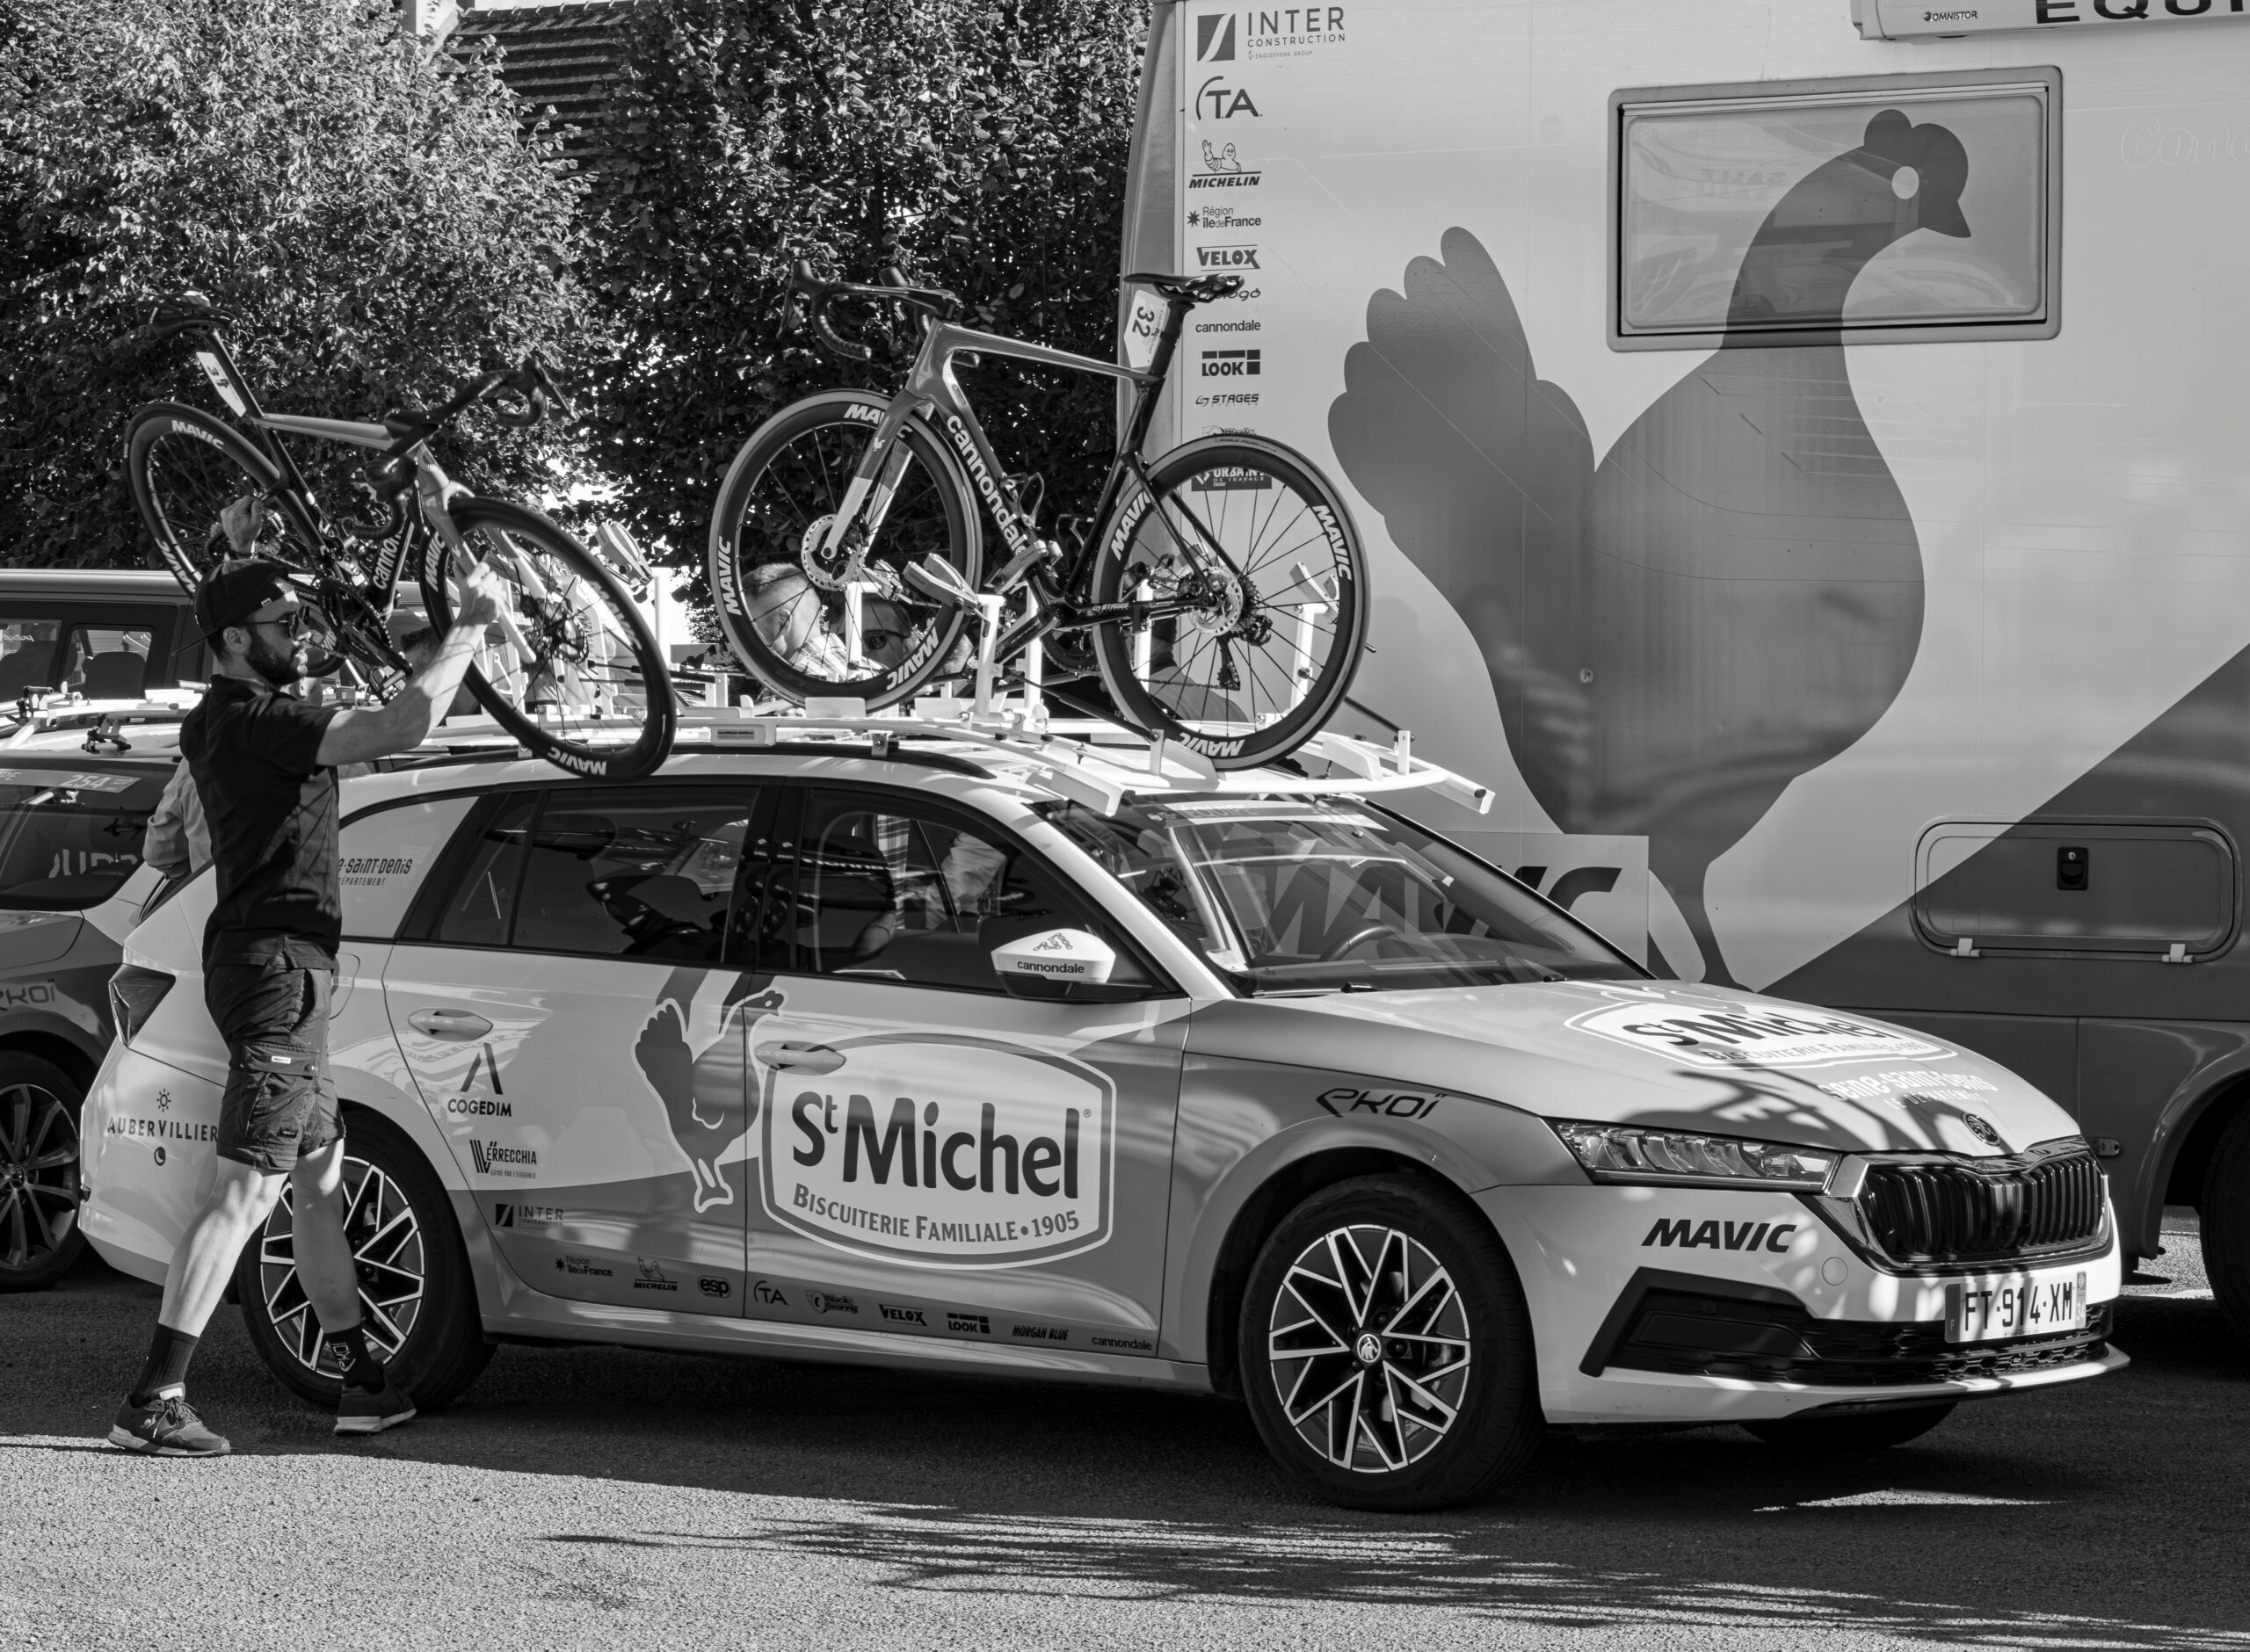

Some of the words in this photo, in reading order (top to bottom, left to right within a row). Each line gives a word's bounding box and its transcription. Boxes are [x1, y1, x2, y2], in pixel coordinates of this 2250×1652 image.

[1248, 6, 1345, 36] INTER
[1932, 11, 1978, 22] OMNISTOR
[1247, 33, 1346, 47] CONSTRUCTION
[1188, 176, 1260, 189] MICHELIN
[1202, 206, 1234, 218] Région
[1196, 247, 1260, 269] VELOX
[1132, 306, 1155, 337] 32
[1195, 320, 1261, 333] cannondale
[1201, 362, 1245, 377] LOOK
[1212, 394, 1259, 404] STAGES
[844, 403, 913, 439] MAC
[171, 420, 224, 450] MAVIC
[1311, 504, 1352, 581] MAVIC
[718, 535, 743, 615] MAVIC
[886, 626, 939, 691] MAVIC
[1179, 732, 1245, 757] MAVIC
[547, 746, 607, 776] MAVIC
[60, 774, 112, 789] 254
[1017, 961, 1085, 974] cannondale
[1661, 1012, 1903, 1044] Michel
[447, 1098, 512, 1117] COGEDIM
[107, 1116, 218, 1142] AUBERVILLIER
[792, 1091, 838, 1167] St
[843, 1094, 1080, 1199] Michel
[519, 1205, 563, 1221] INTER
[793, 1183, 910, 1237] BISCUITERIE
[1641, 1218, 1797, 1253] MAVIC
[634, 1281, 678, 1292] MICHELIN
[879, 1304, 927, 1326] VELOX
[1965, 1282, 2072, 1332] FT-914-XM
[948, 1321, 978, 1333] LOOK
[1012, 1324, 1047, 1339] MORGAN
[1048, 1328, 1070, 1341] BLUE
[1092, 1337, 1152, 1351] cannondale
